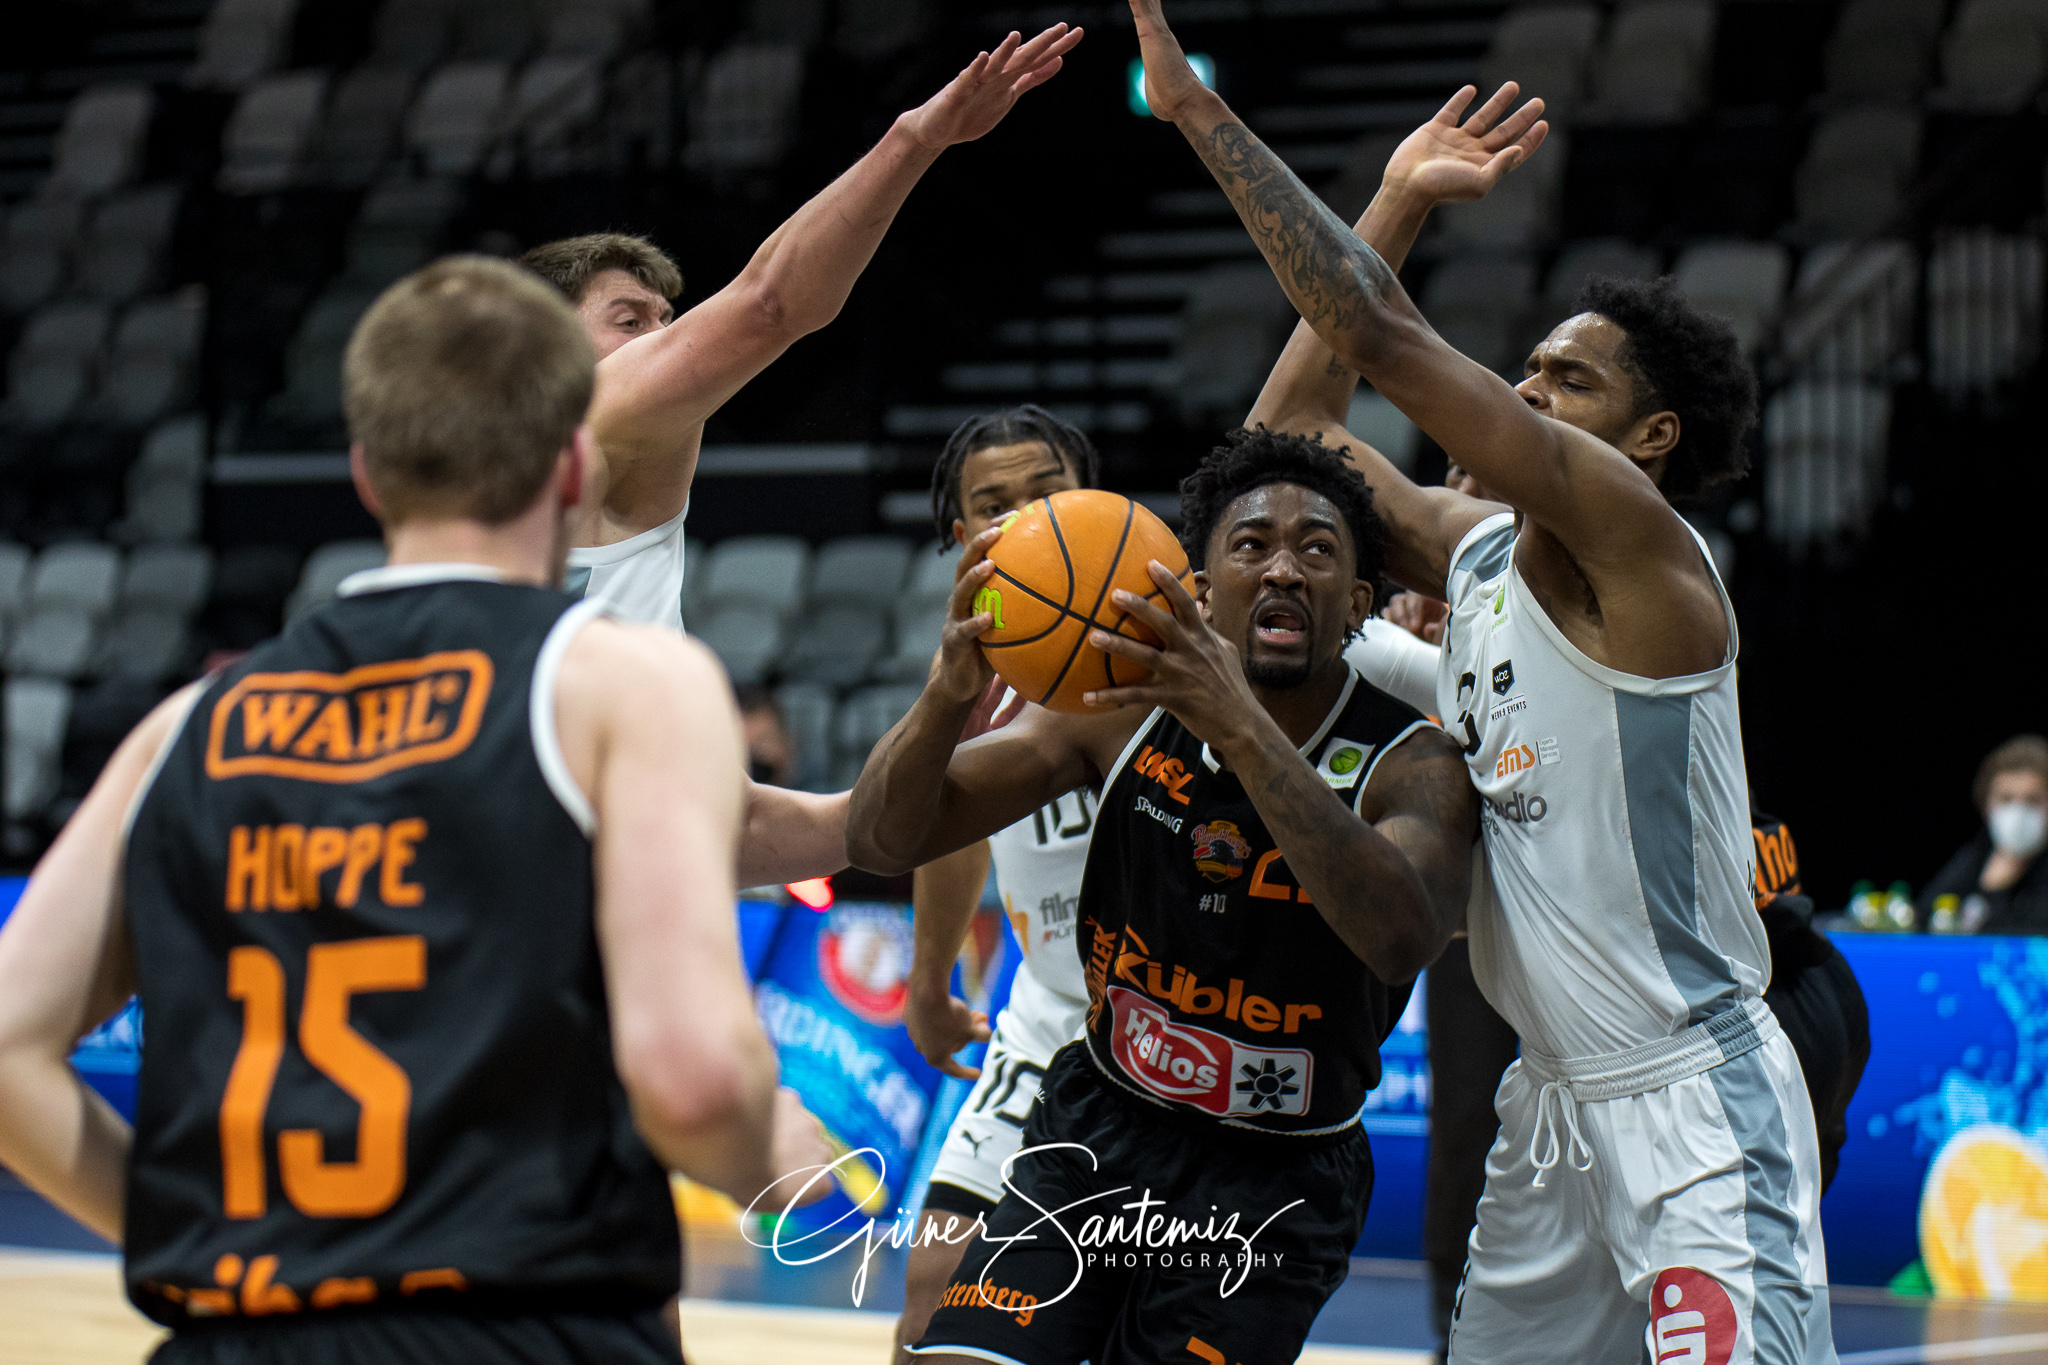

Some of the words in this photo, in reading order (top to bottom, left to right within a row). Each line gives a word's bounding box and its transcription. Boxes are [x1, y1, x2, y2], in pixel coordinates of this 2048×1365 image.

[241, 679, 449, 757] WAHL
[1496, 743, 1535, 778] EMS
[1134, 795, 1183, 835] SPALDING
[225, 819, 427, 912] HOPPE
[1114, 923, 1323, 1034] Kübler
[220, 935, 427, 1220] 15
[1124, 1007, 1220, 1089] Helios
